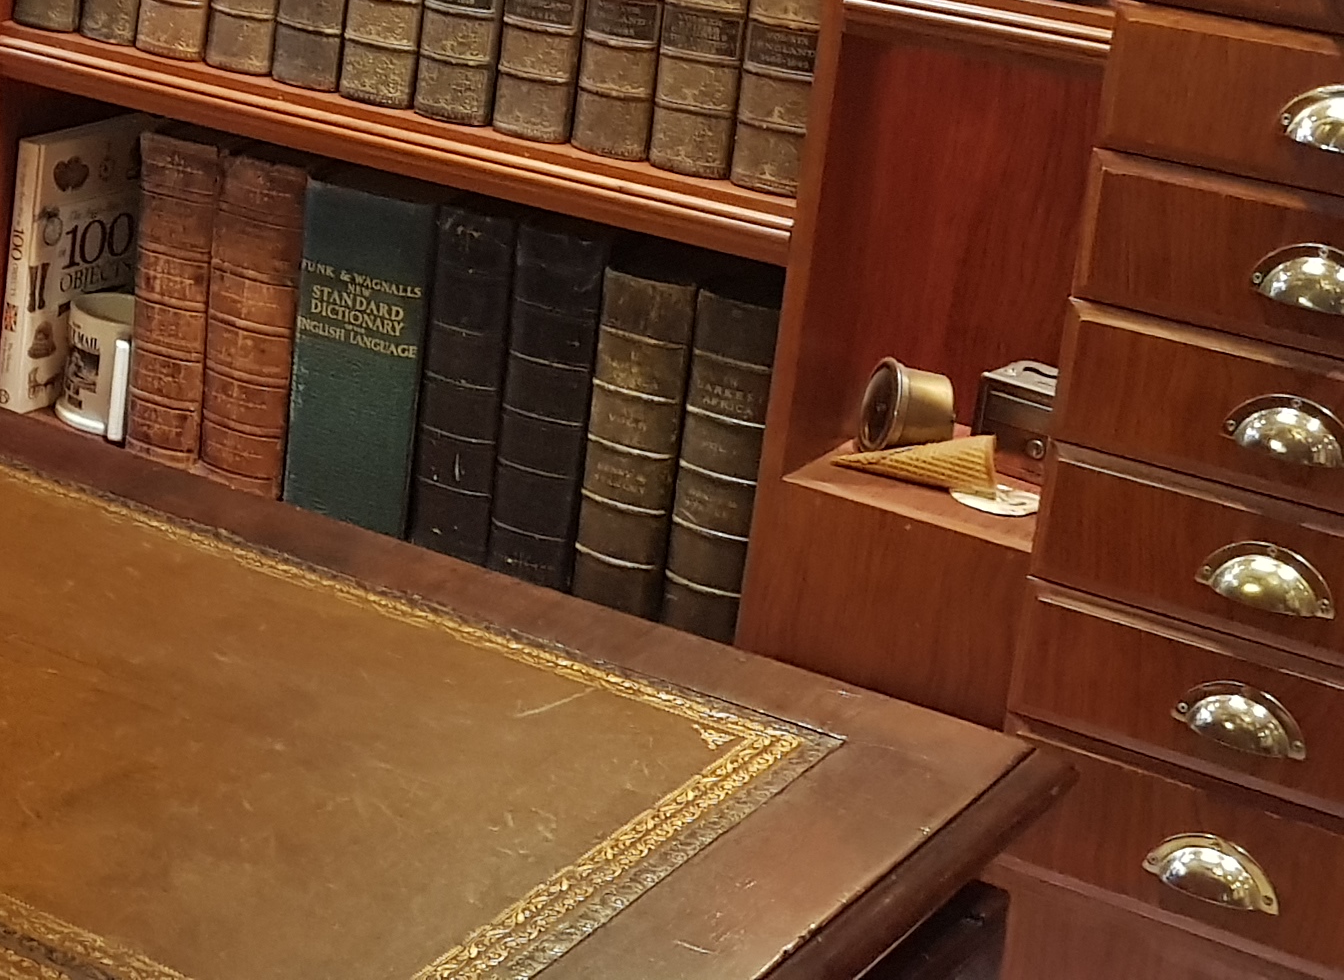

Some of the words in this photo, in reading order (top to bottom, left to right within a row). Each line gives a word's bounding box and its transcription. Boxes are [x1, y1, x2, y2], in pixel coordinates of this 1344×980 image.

[10, 228, 26, 262] 100
[62, 212, 134, 270] 100
[302, 259, 335, 278] FUNK
[340, 270, 351, 281] &
[354, 272, 422, 298] WAGNALLS
[348, 283, 371, 297] NEW
[311, 299, 405, 337] DICTIONARY
[312, 285, 404, 321] STANDARD
[349, 331, 418, 359] LANGUAGE
